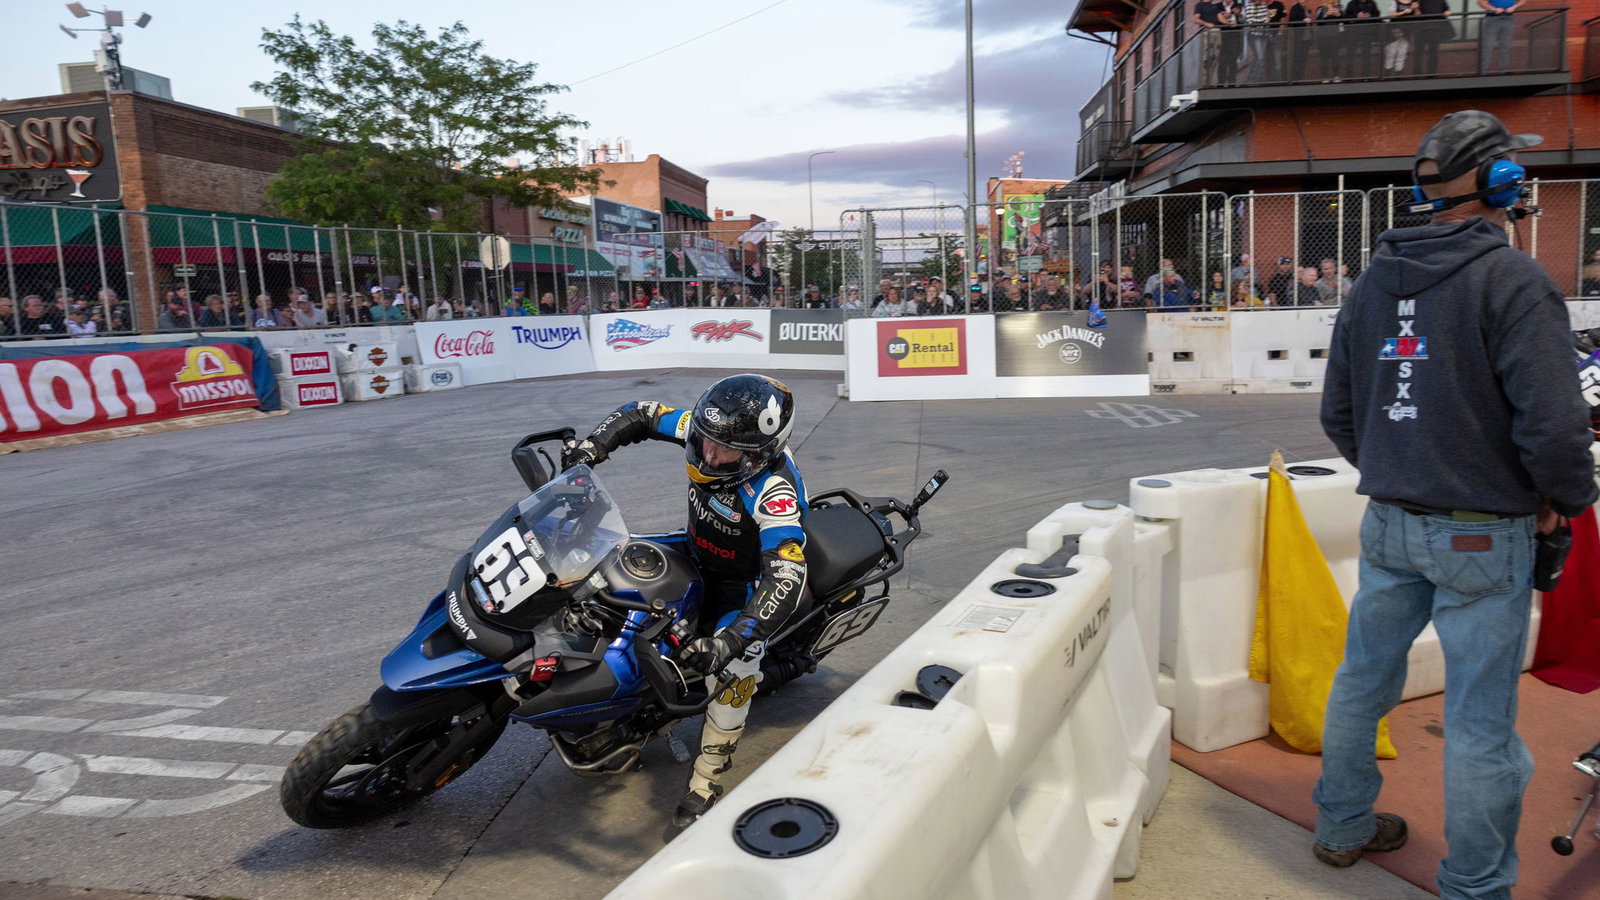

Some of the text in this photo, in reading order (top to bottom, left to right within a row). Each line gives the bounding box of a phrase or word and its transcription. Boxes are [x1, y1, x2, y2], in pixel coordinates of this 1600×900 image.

[267, 252, 299, 262] OASS
[434, 330, 495, 359] Coca-Cola
[511, 325, 582, 350] TRIUMPH
[912, 342, 955, 353] Rental
[1036, 324, 1106, 349] JACK DANIEL'S
[688, 487, 742, 537] OnlyFans
[448, 591, 470, 634] TRIUMPH
[759, 579, 793, 620] cardo
[817, 603, 883, 650] 69
